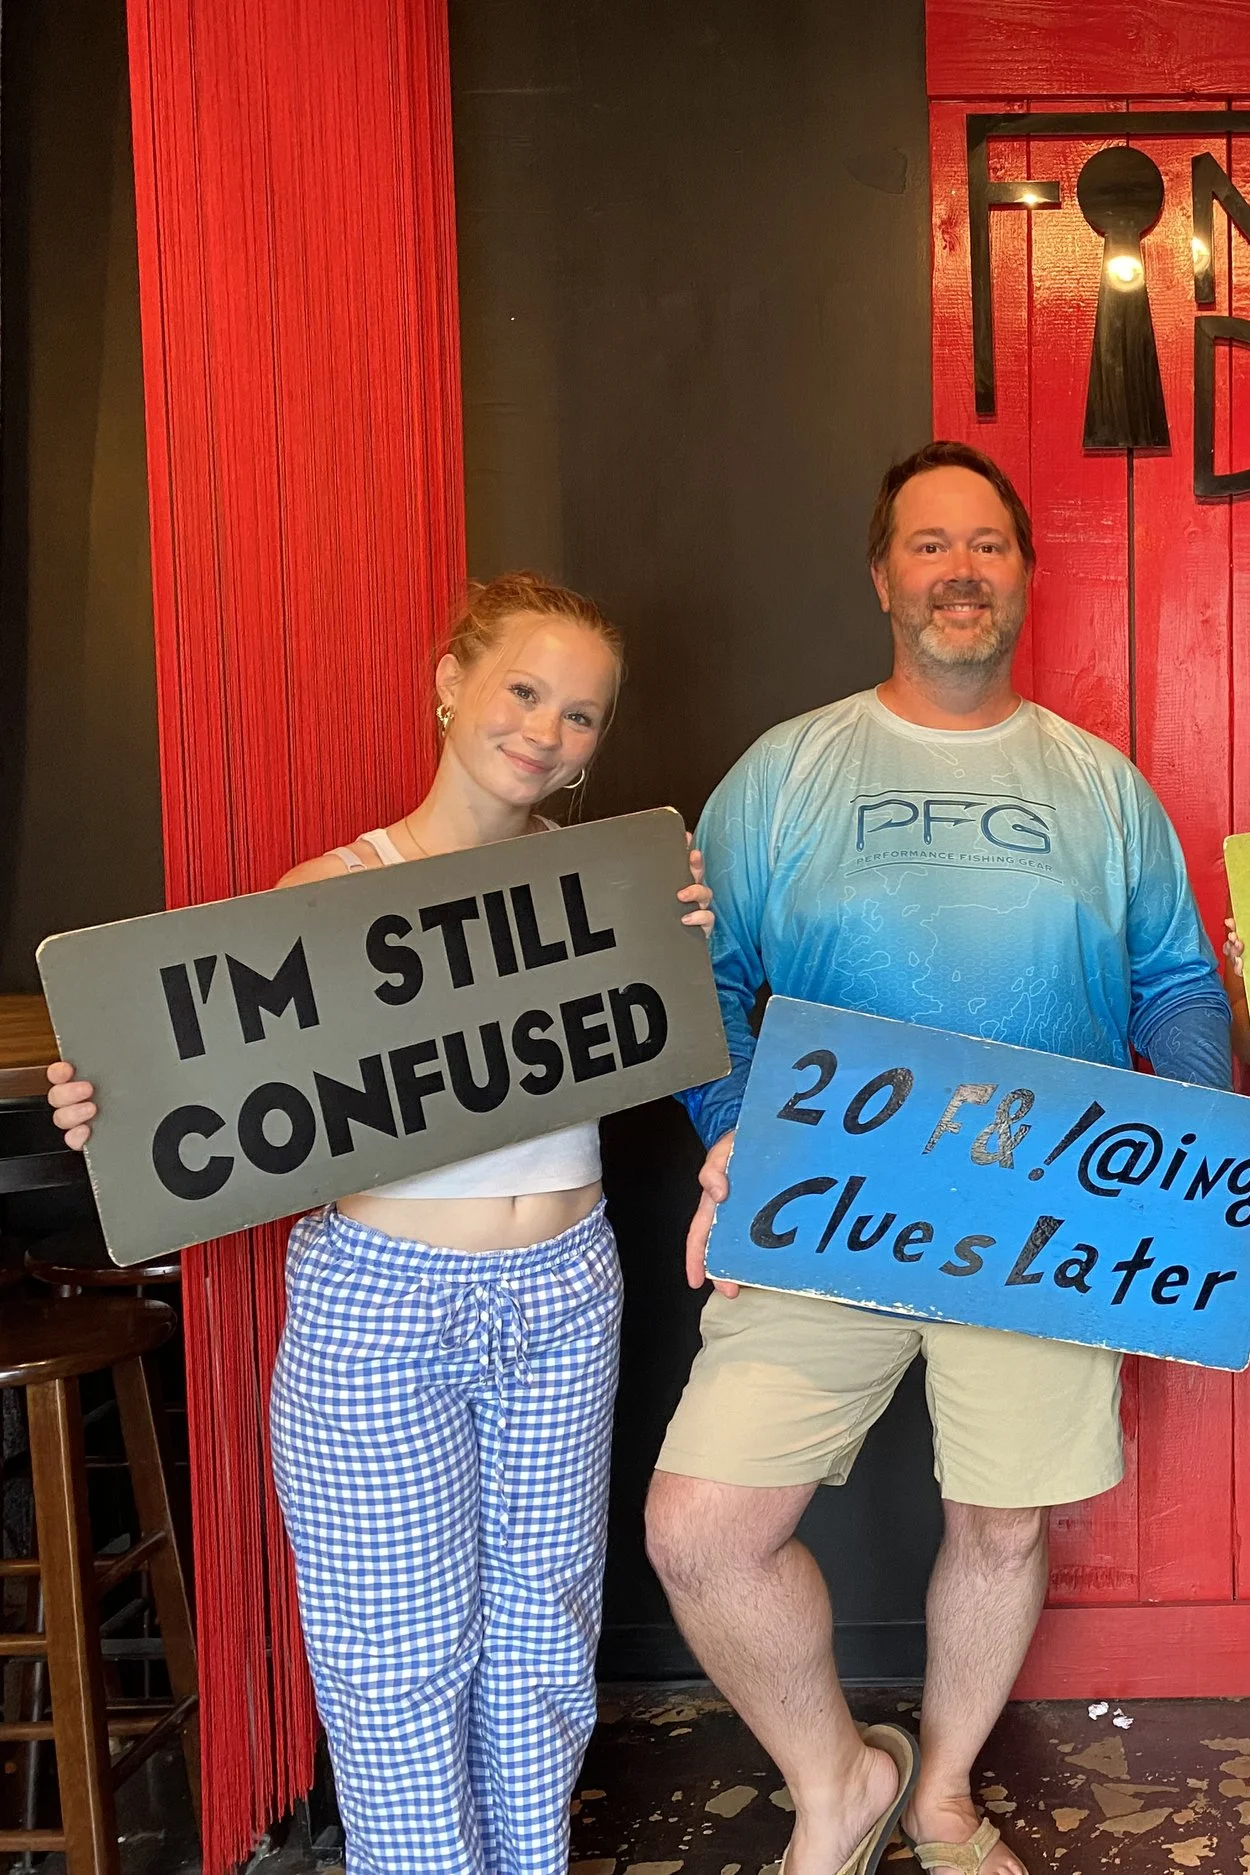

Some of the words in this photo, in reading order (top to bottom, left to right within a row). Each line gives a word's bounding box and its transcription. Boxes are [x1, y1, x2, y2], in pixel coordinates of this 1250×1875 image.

[856, 799, 1051, 854] PFG
[856, 850, 955, 865] PERFORMANCE
[959, 853, 1015, 865] FISHING
[1018, 857, 1053, 872] GEAR
[159, 936, 320, 1060] I'M
[366, 872, 616, 1006] STILL
[152, 982, 669, 1200] CONFUSED
[776, 1049, 914, 1135] 20
[749, 1175, 997, 1277] Clues
[1005, 1215, 1237, 1311] Later
